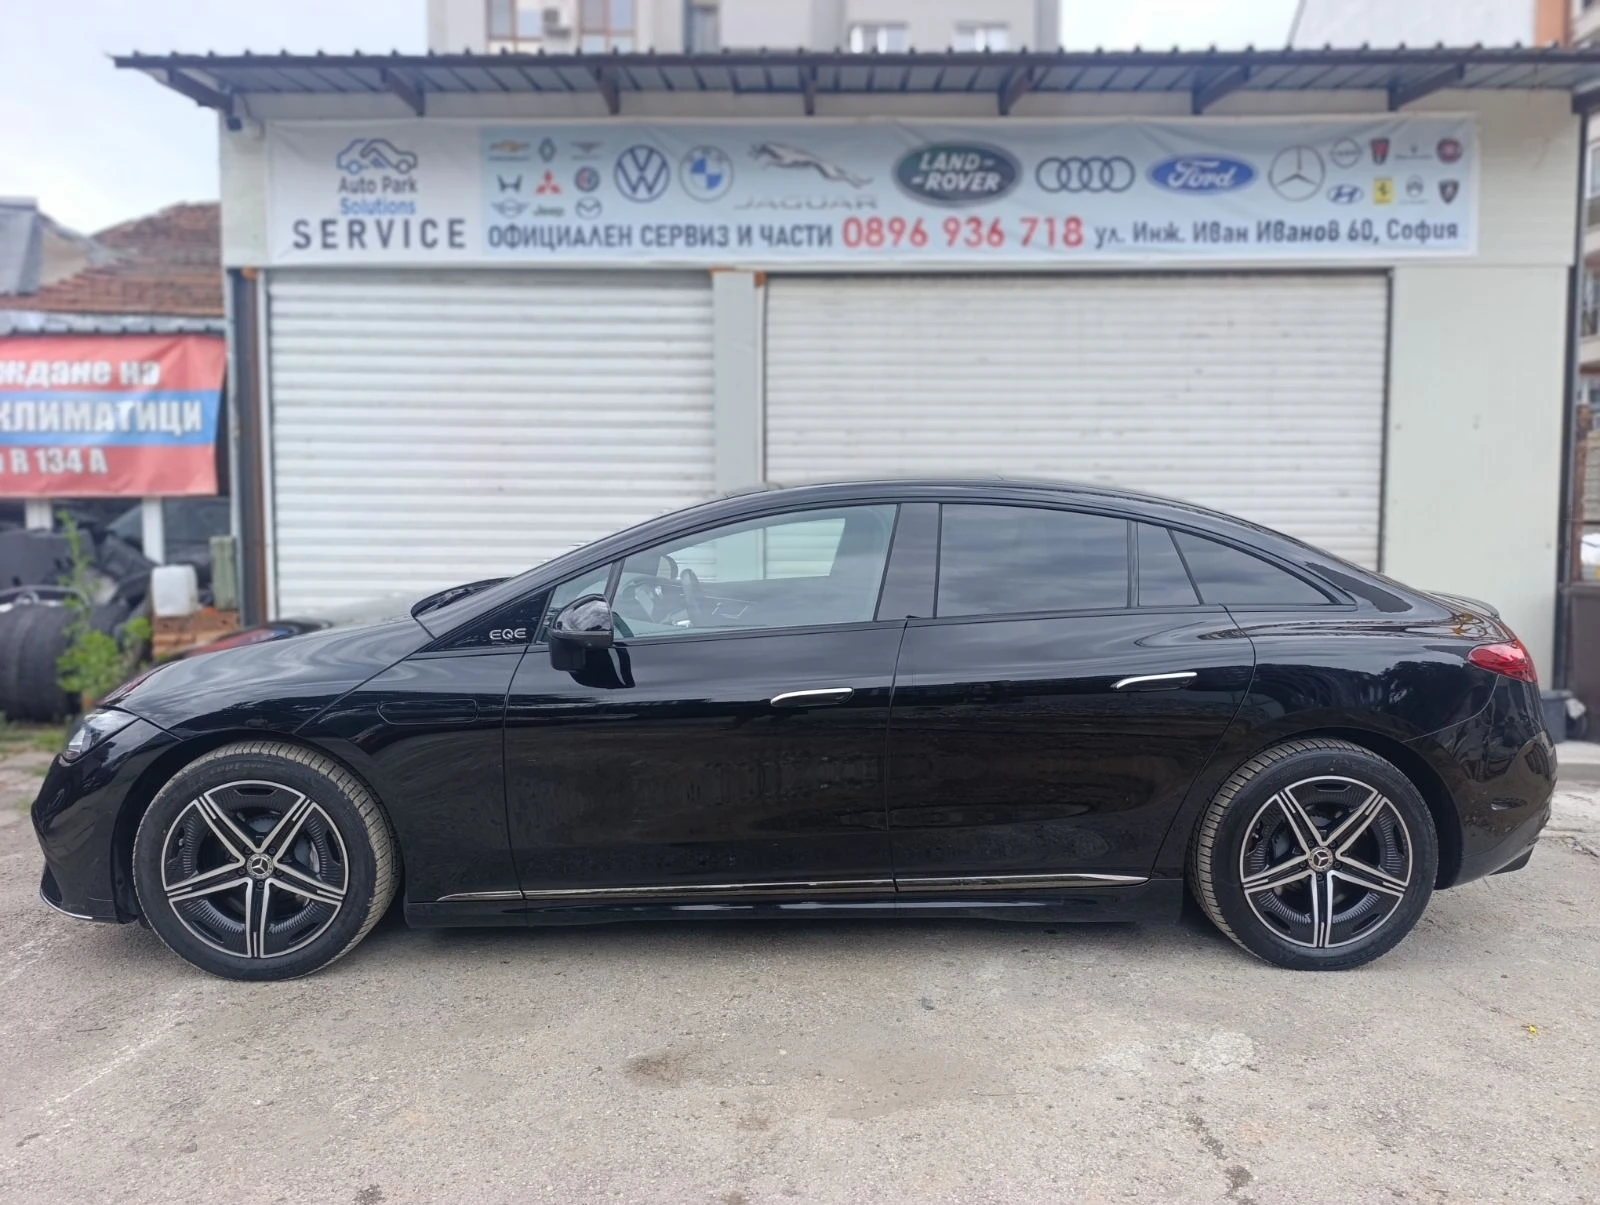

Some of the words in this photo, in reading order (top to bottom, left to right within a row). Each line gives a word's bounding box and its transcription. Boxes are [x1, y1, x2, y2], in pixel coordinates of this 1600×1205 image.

[338, 176, 379, 195] Auto
[382, 176, 418, 195] Park
[1168, 160, 1236, 189] Ford
[339, 198, 416, 216] Solutions
[732, 194, 879, 211] JAGUAR
[292, 217, 467, 250] SERVICE
[488, 223, 631, 252] ОФИЦИАЛЕН
[641, 225, 728, 248] СЕРВИЗ
[737, 225, 752, 247] И
[760, 224, 832, 248] ЧАСТИ
[842, 217, 929, 249] 0896
[943, 217, 1005, 249] 936
[1020, 216, 1084, 249] 718
[1094, 229, 1125, 249] ул.
[1132, 222, 1184, 244] Инж.
[1192, 221, 1248, 244] Иван
[1256, 220, 1338, 244] Иванов
[1347, 219, 1379, 244] 60,
[1387, 218, 1458, 244] София
[119, 361, 161, 386] на
[10, 448, 29, 475] R
[34, 448, 83, 475] 134
[489, 628, 528, 640] EQE
